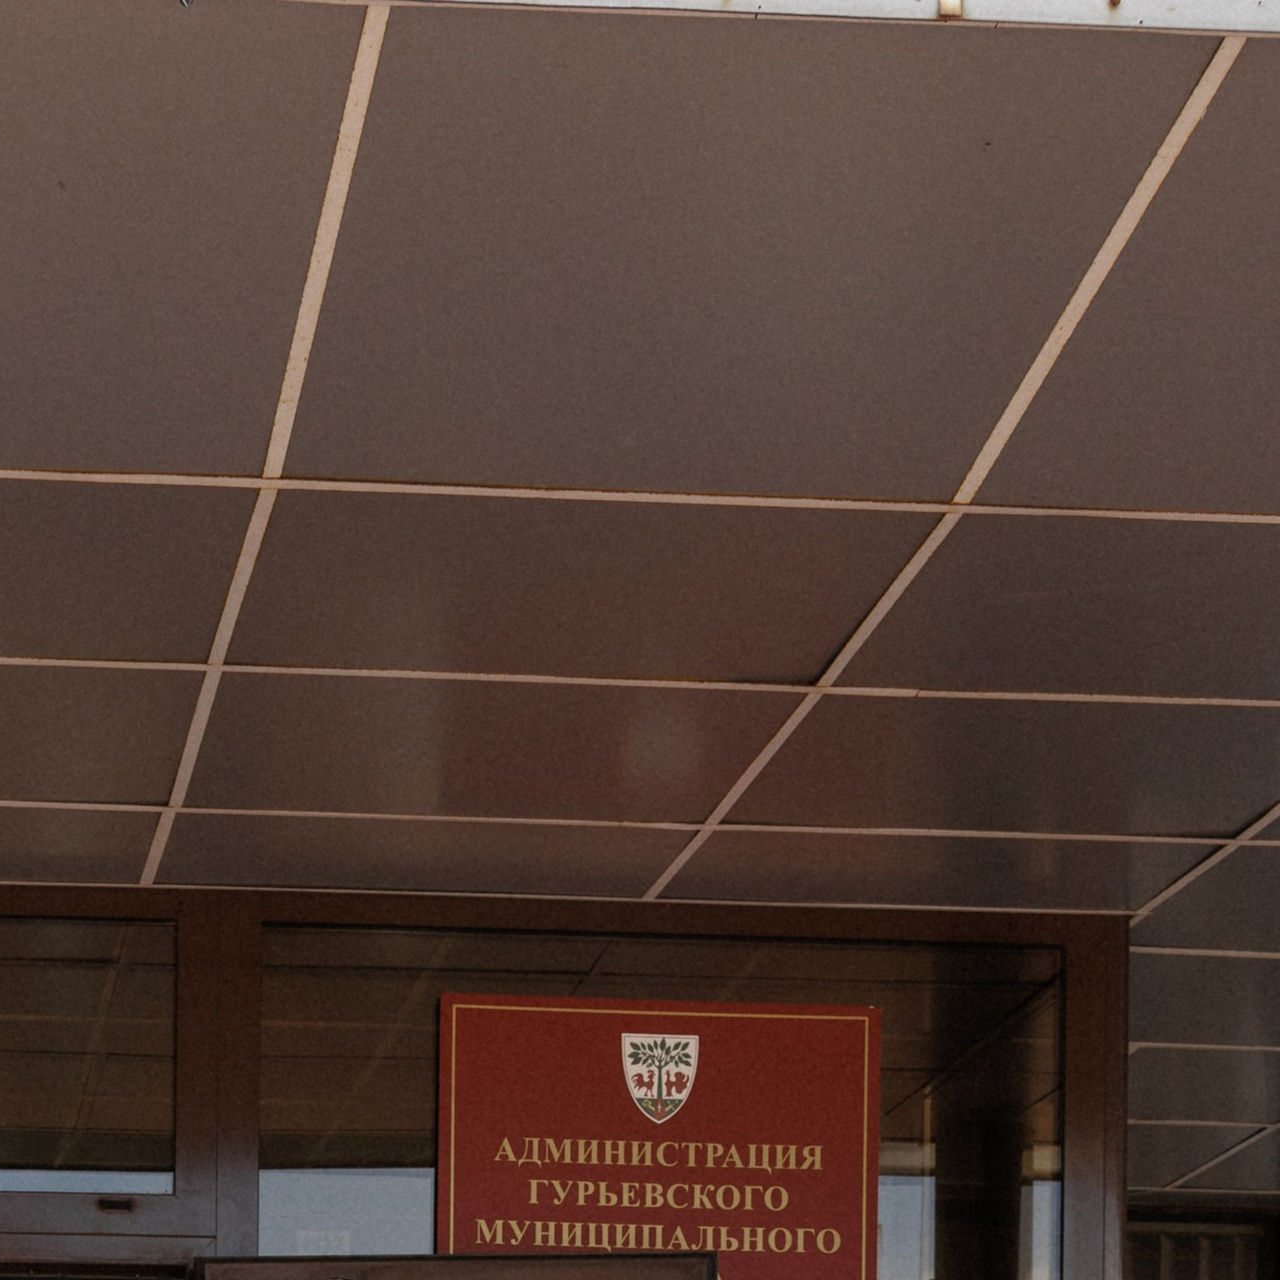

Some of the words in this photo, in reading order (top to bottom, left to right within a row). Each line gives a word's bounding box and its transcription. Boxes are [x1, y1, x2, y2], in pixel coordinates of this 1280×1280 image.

[494, 1136, 824, 1174] АДМИНИСТРАЦИЯ
[528, 1179, 789, 1211] ГУРЬЕВСКОГО
[475, 1219, 841, 1254] МУНИЦИПАЛЬНОГО
